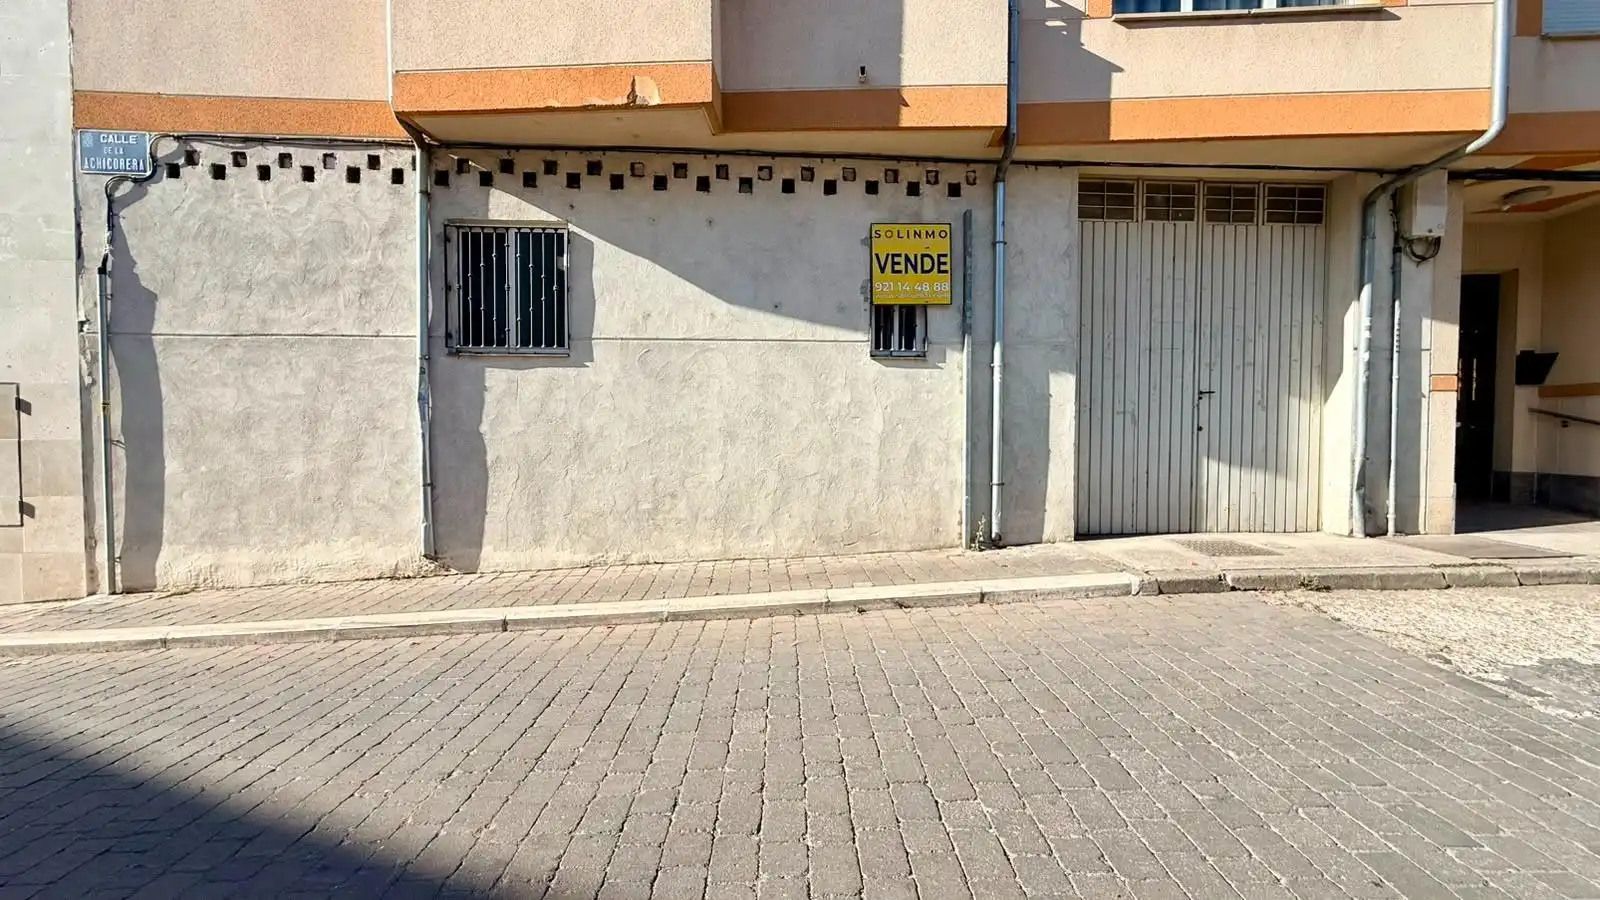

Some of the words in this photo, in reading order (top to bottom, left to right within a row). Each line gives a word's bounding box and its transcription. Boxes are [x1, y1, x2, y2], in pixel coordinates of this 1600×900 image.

[100, 133, 137, 144] CALLE
[104, 146, 113, 154] DE
[115, 147, 124, 155] LA
[83, 157, 145, 170] ACHICORERA
[874, 229, 948, 239] SOLINMO
[875, 253, 949, 274] VENDE
[875, 282, 893, 291] 921
[898, 282, 910, 291] 14
[914, 282, 930, 291] 48
[933, 282, 949, 292] 88
